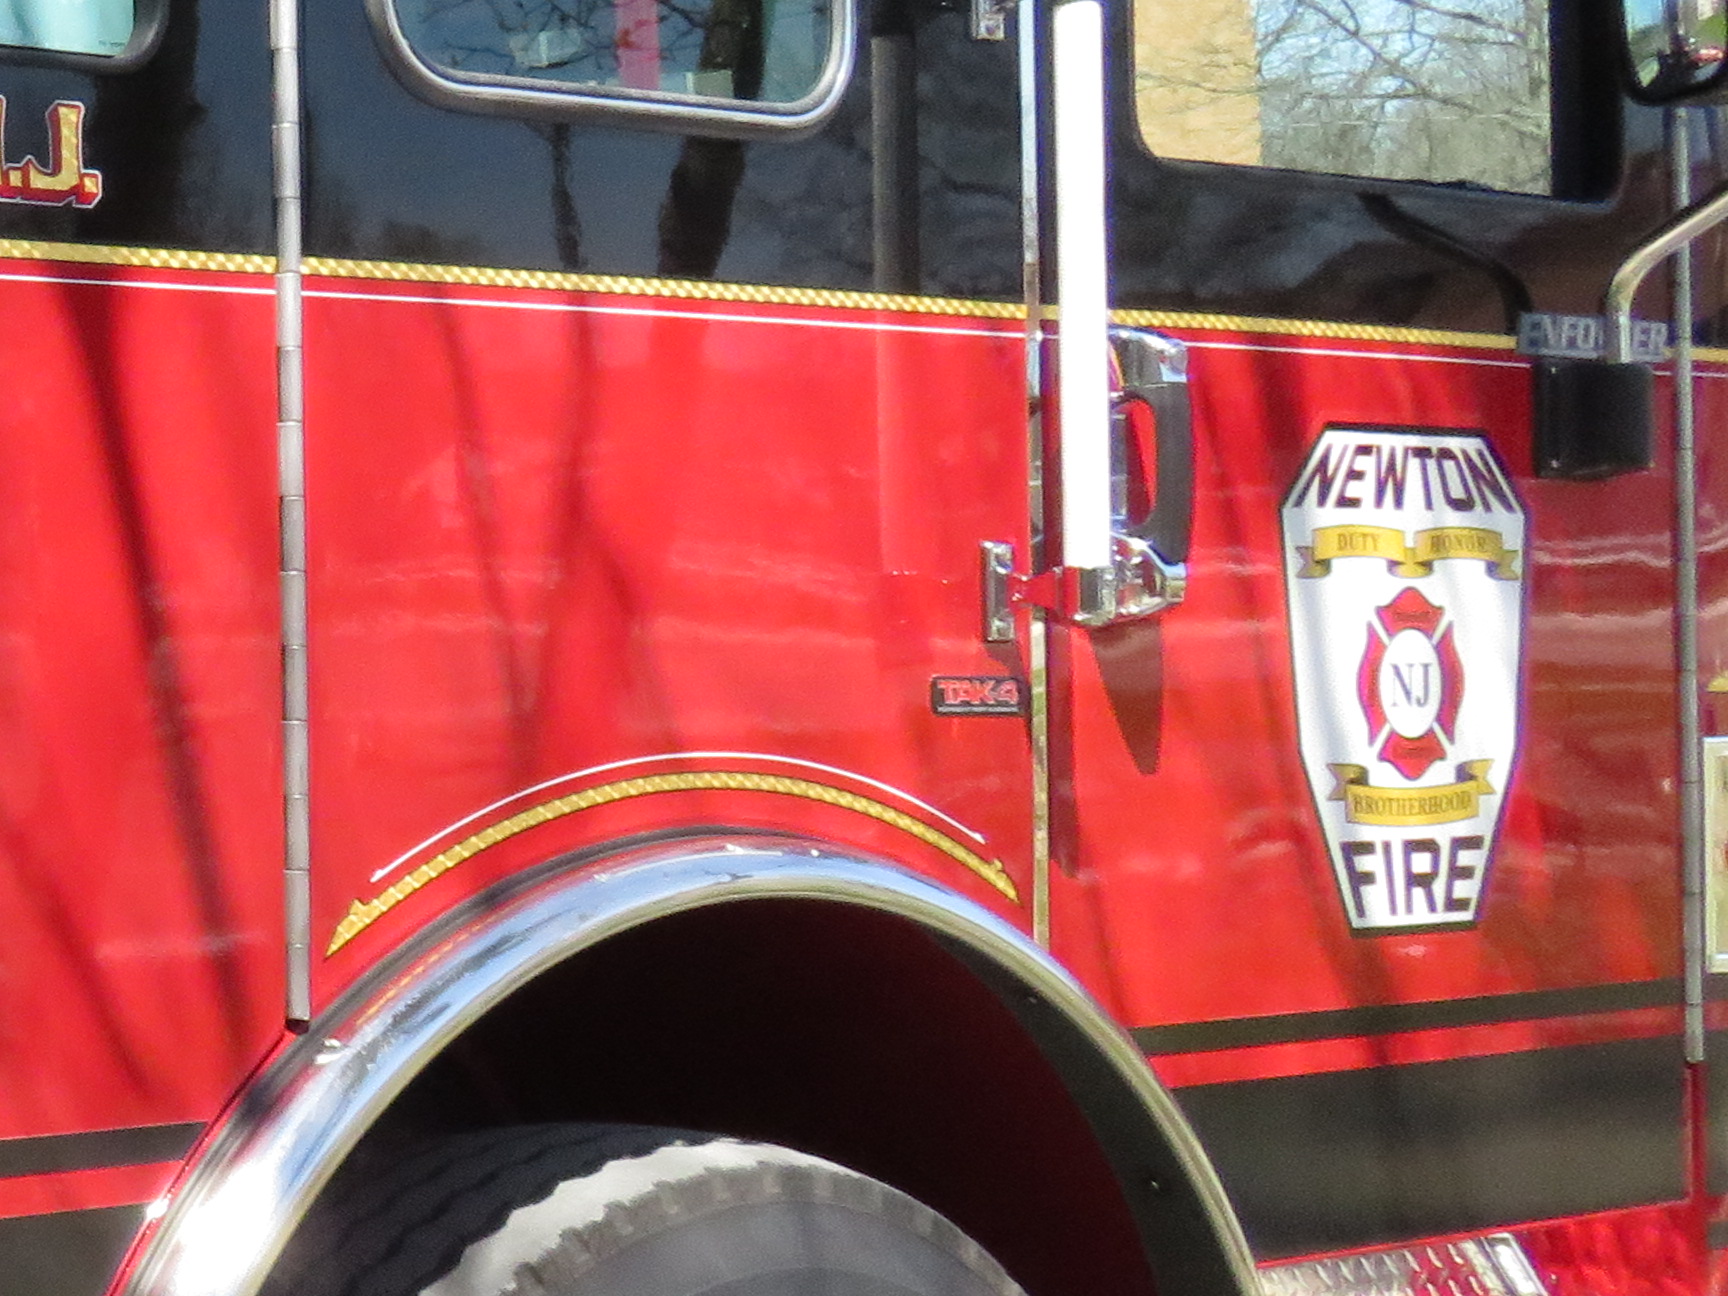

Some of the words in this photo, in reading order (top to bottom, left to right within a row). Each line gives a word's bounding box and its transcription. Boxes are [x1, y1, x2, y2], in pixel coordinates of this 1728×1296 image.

[1519, 312, 1669, 355] ENFOER
[1292, 443, 1518, 514] NEWTON
[1336, 532, 1381, 552] DUTY
[1391, 661, 1433, 708] NJ
[1353, 790, 1471, 817] BROTHERHOOD
[1339, 835, 1485, 919] FIRE
